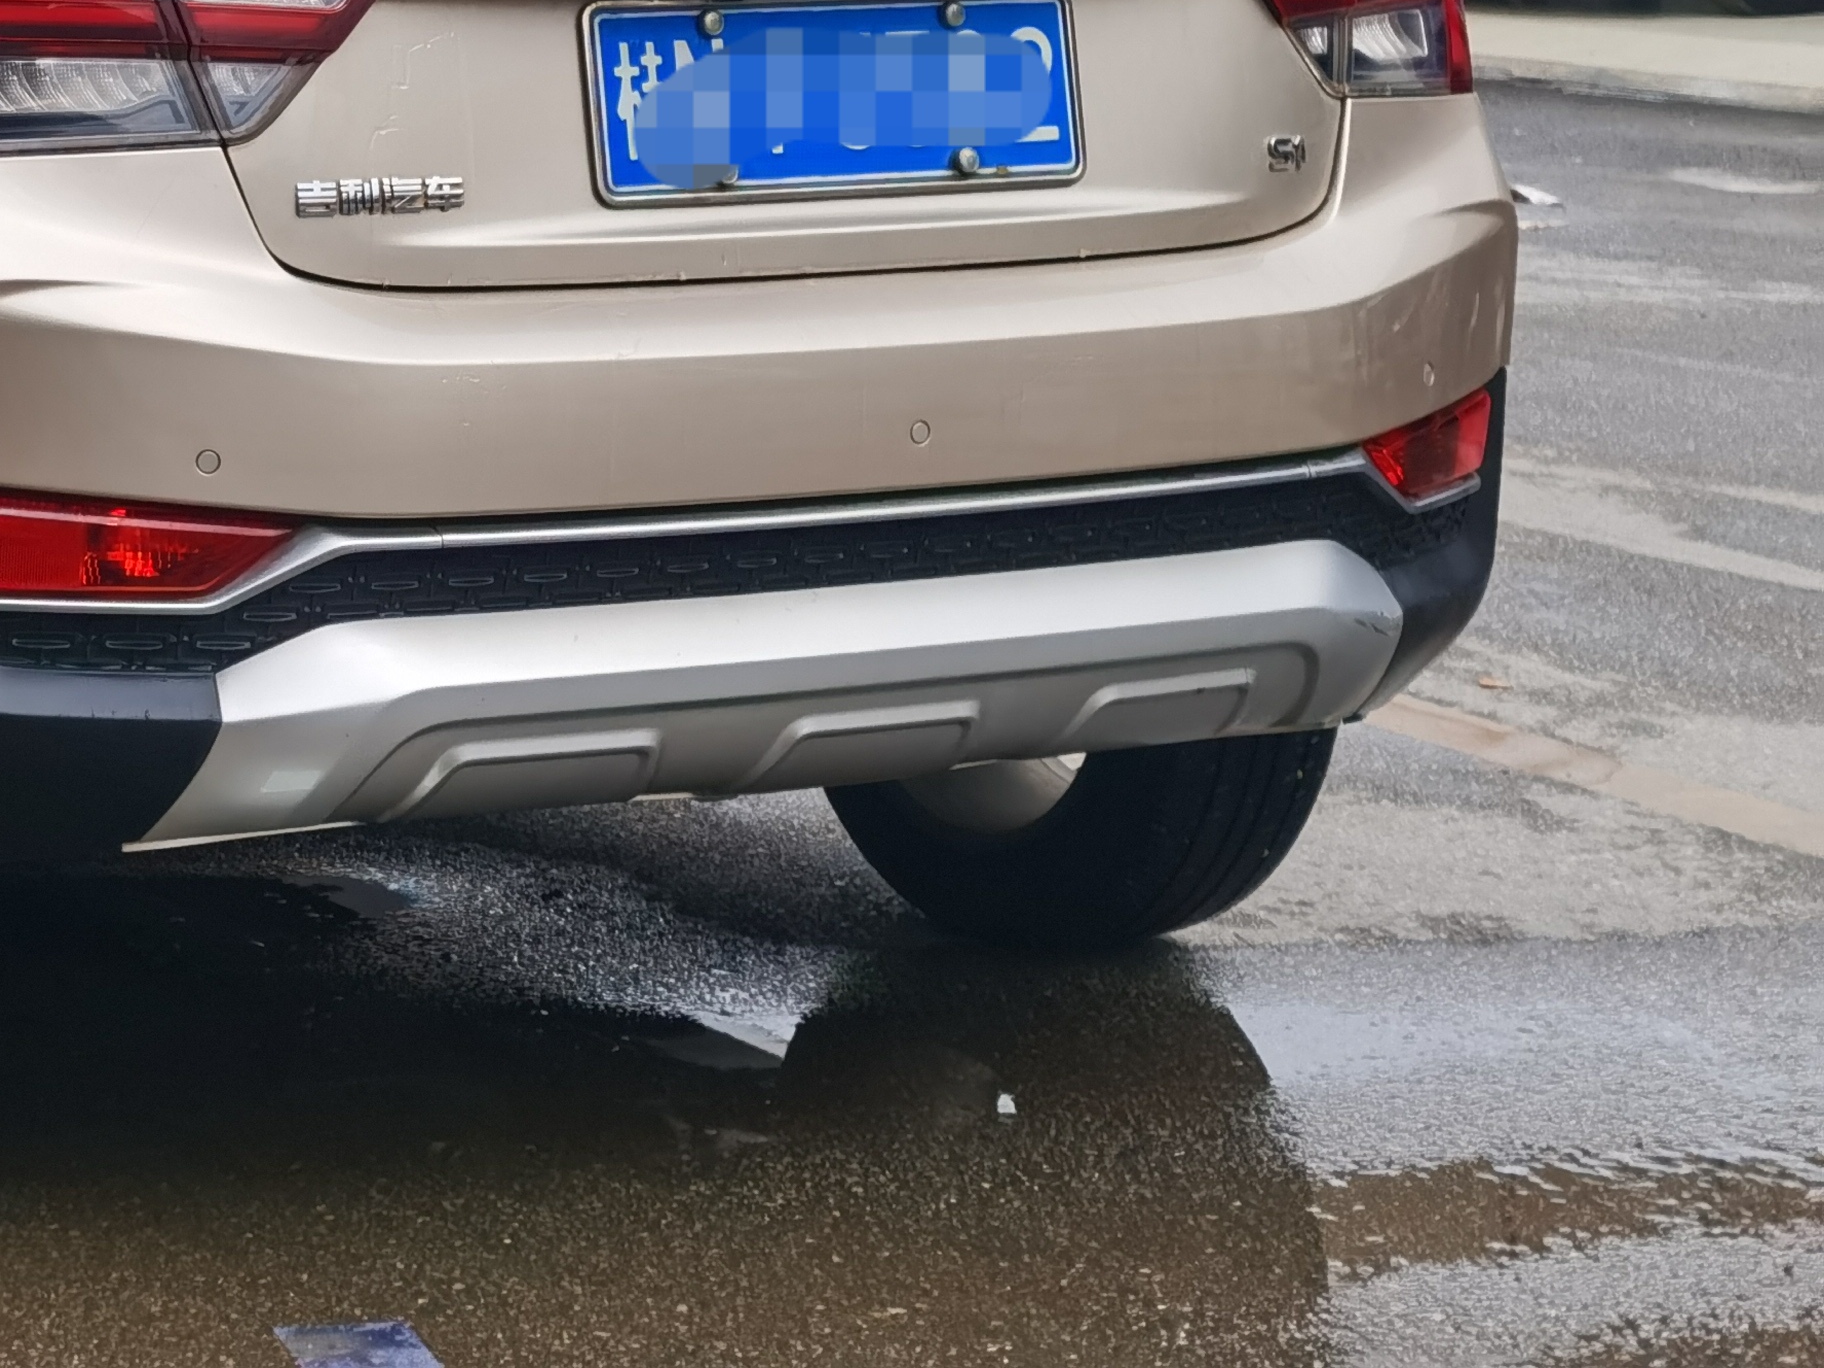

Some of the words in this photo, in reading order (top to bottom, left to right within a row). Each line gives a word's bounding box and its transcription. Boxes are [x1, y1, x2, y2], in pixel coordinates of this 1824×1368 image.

[1266, 134, 1306, 173] S1
[295, 176, 466, 219] 吉利汽车
